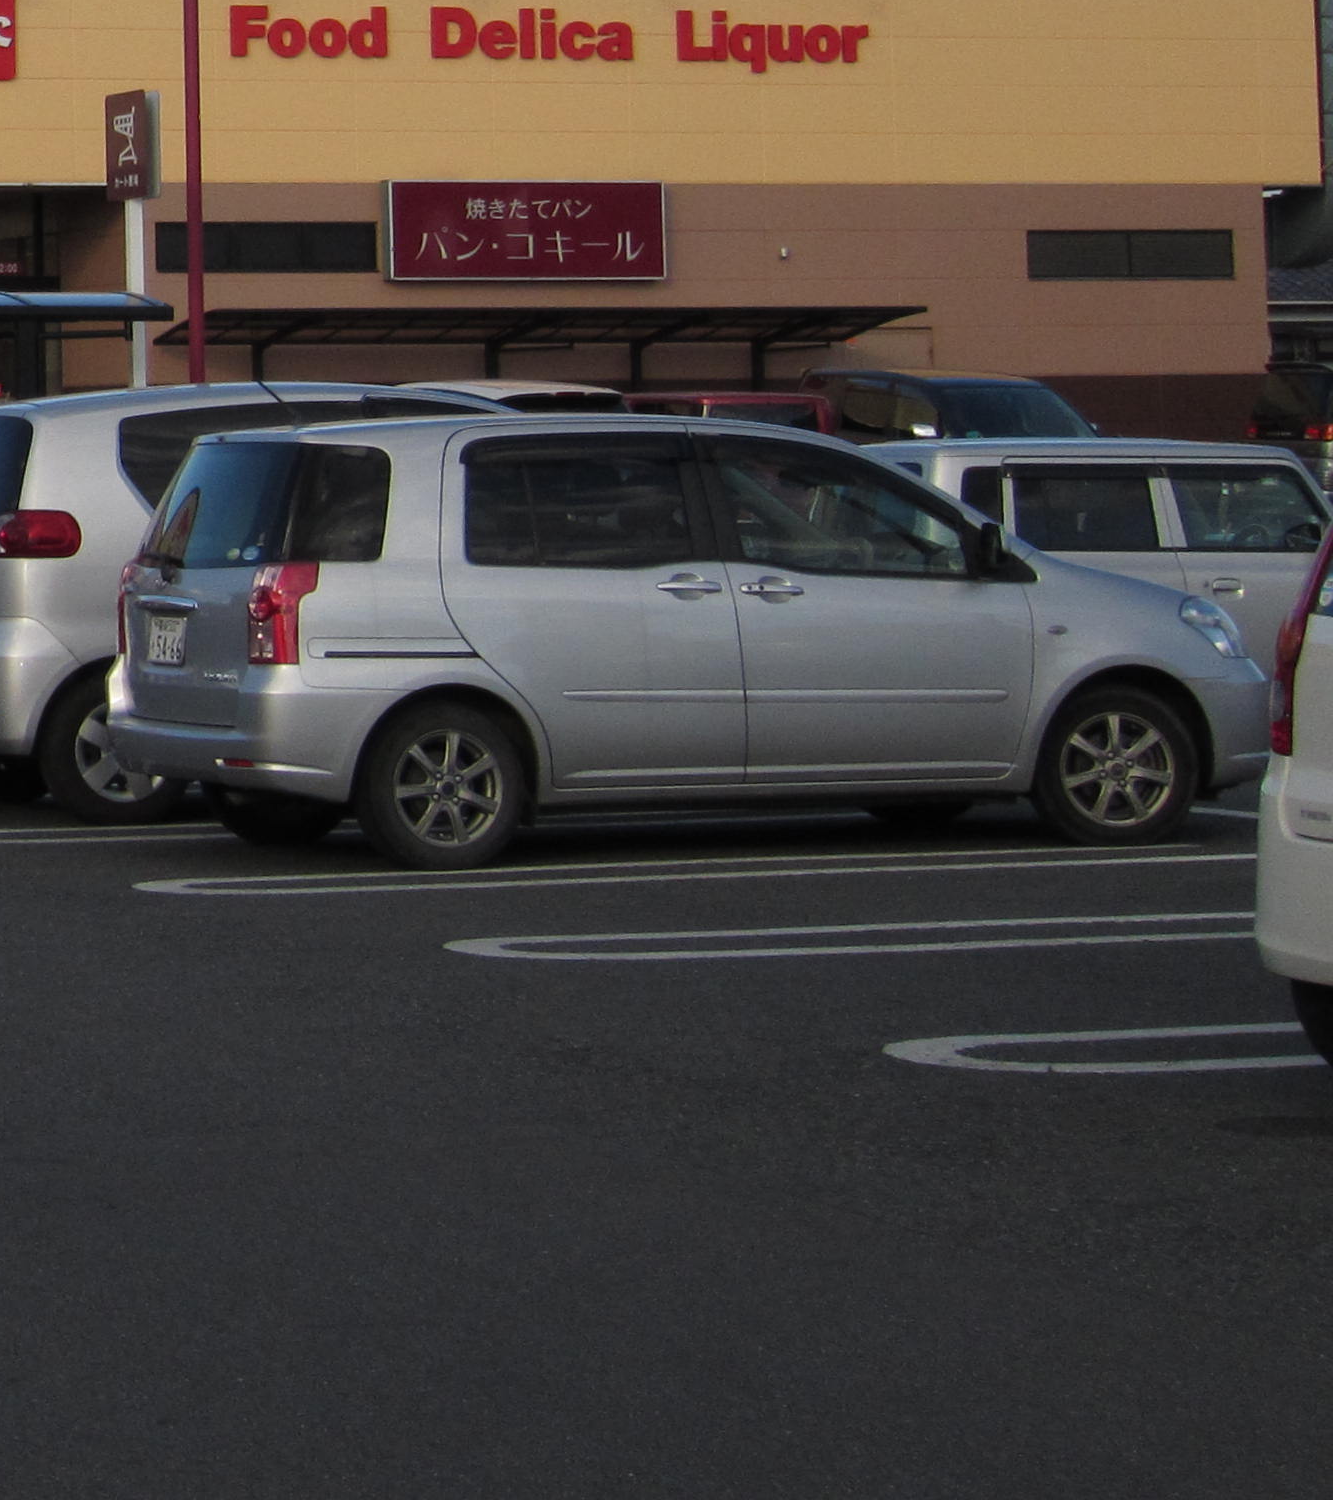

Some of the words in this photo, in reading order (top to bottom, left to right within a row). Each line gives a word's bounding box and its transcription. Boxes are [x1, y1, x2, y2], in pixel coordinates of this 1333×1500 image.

[229, 5, 389, 60] Food
[430, 6, 634, 61] Delica
[675, 10, 870, 75] Liquor
[465, 197, 593, 221] 焼きたてパン
[414, 226, 646, 263] パン・コキール
